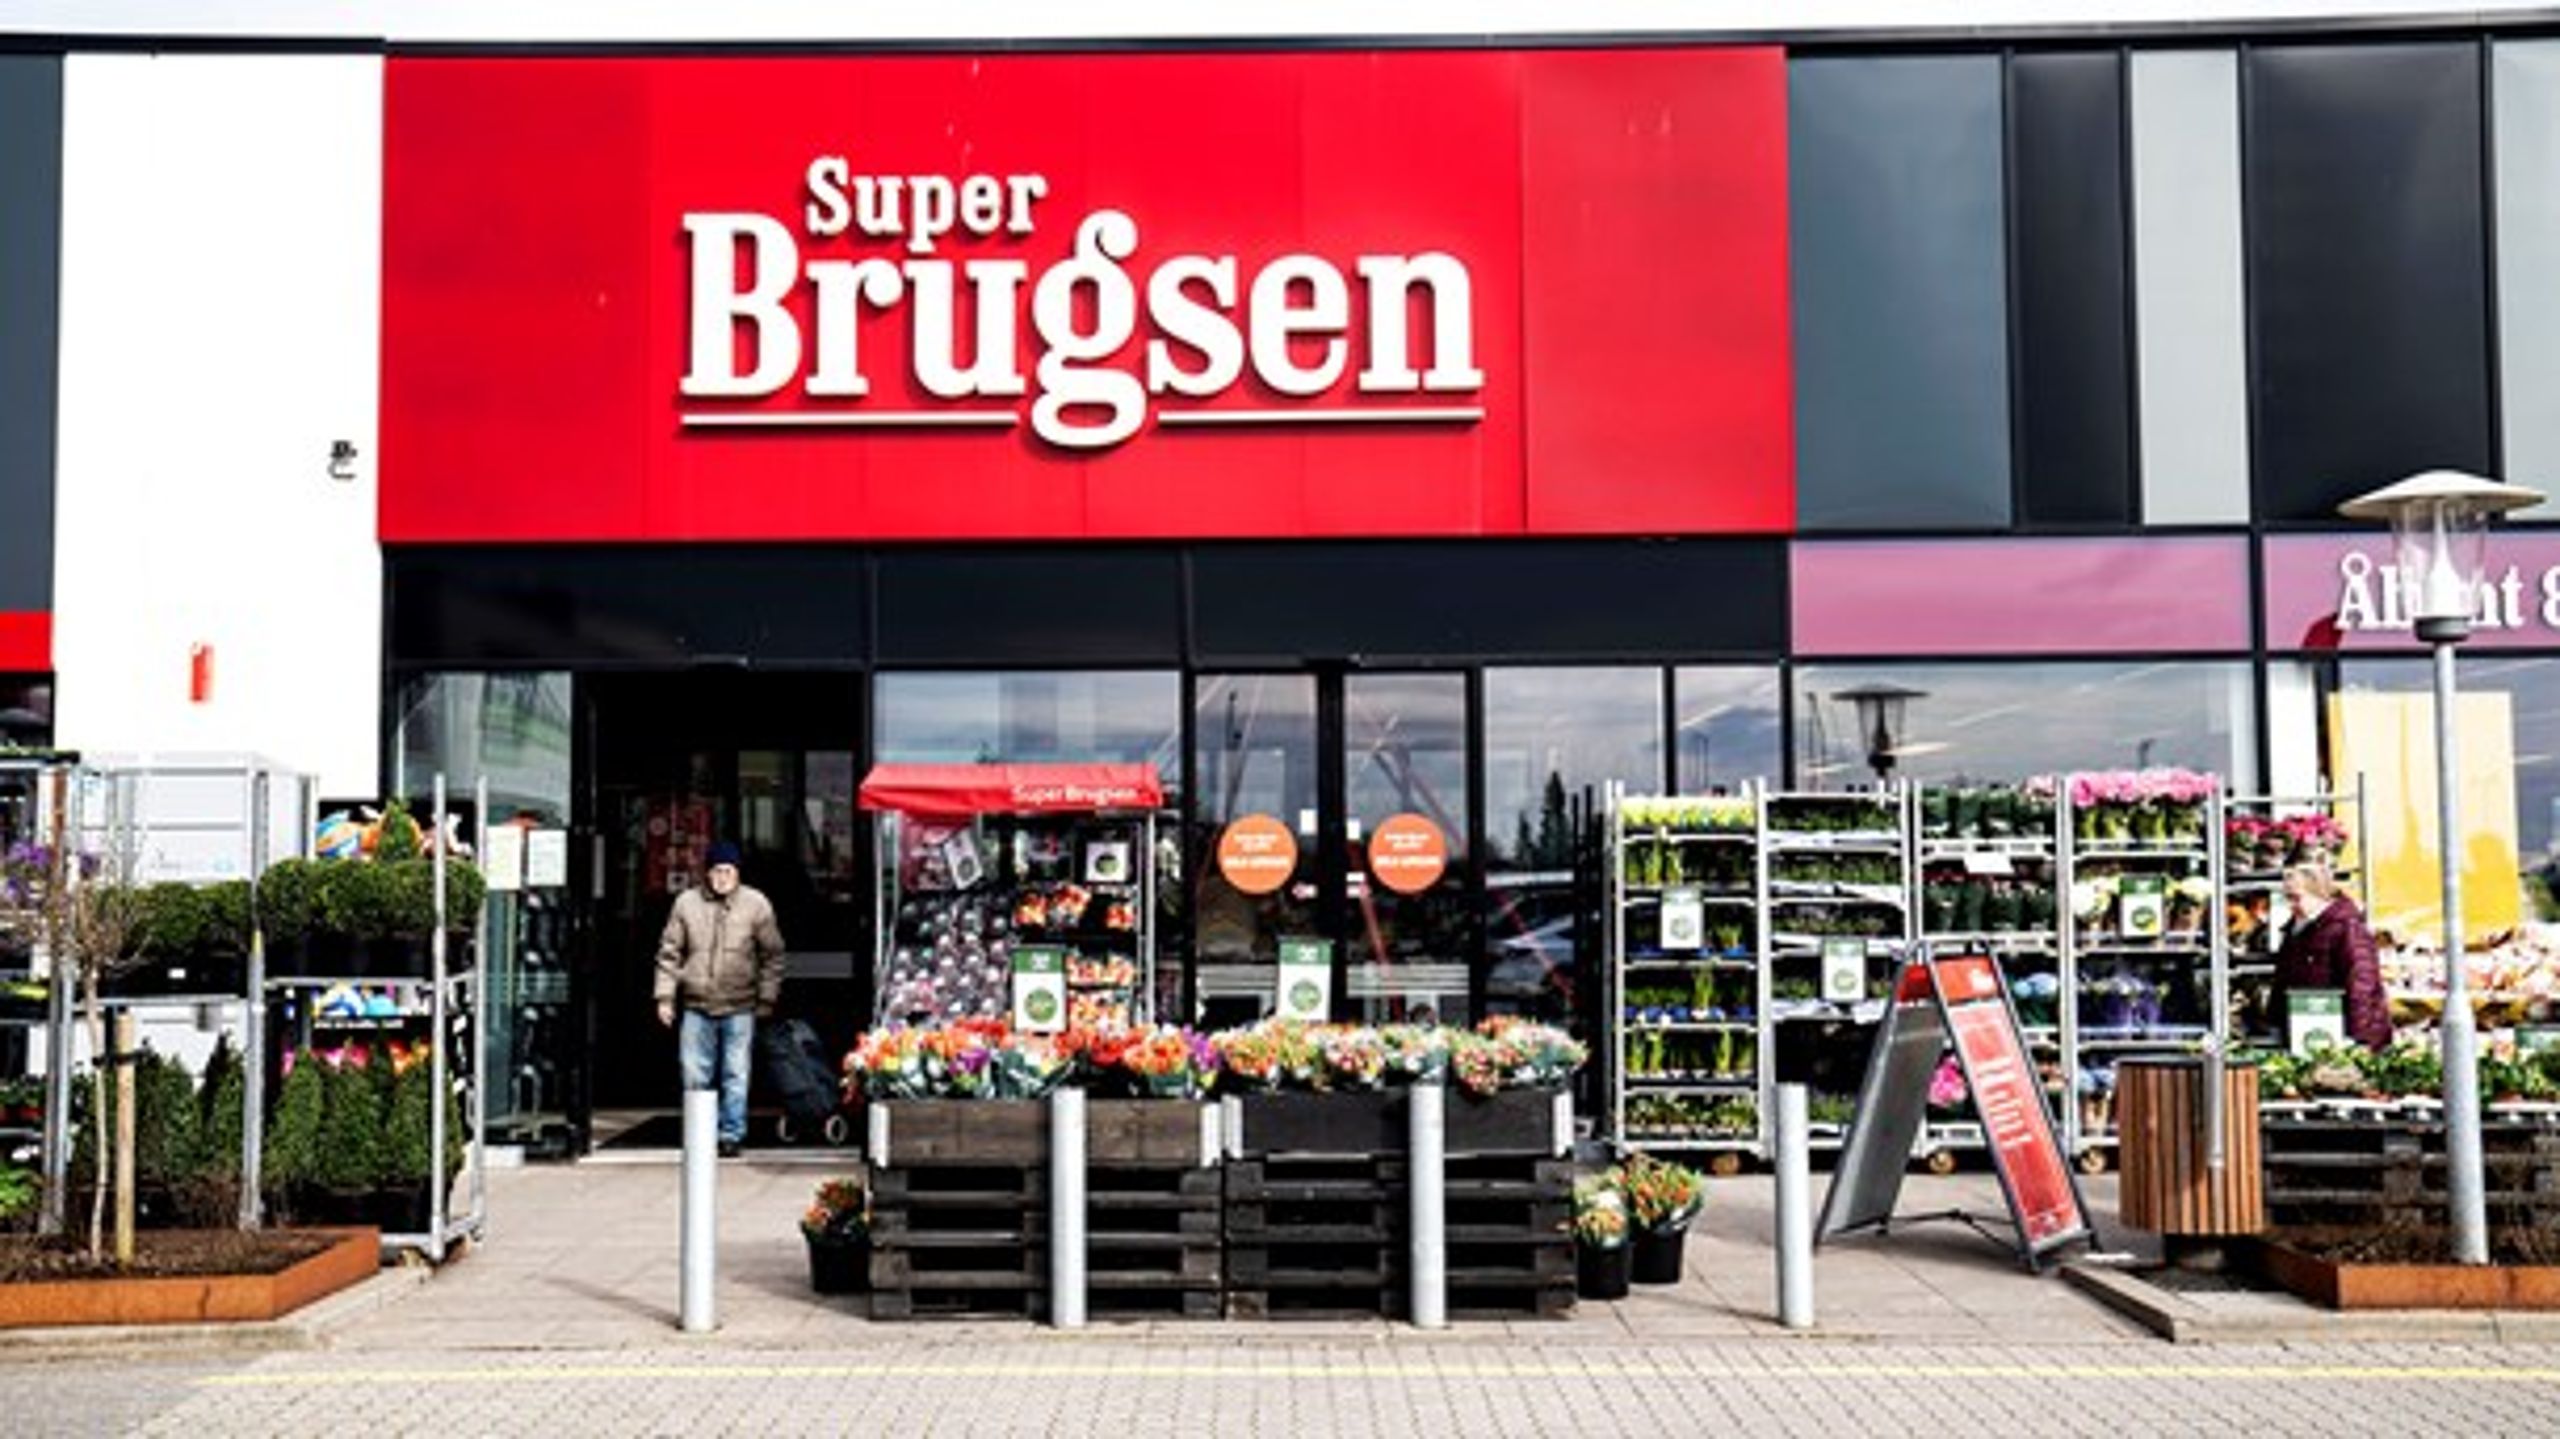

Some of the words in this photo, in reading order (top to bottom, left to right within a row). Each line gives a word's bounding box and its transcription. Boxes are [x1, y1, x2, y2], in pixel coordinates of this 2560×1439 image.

[806, 156, 1047, 253] Super
[679, 209, 1485, 448] Brugsen
[2333, 551, 2526, 630] Åbnt
